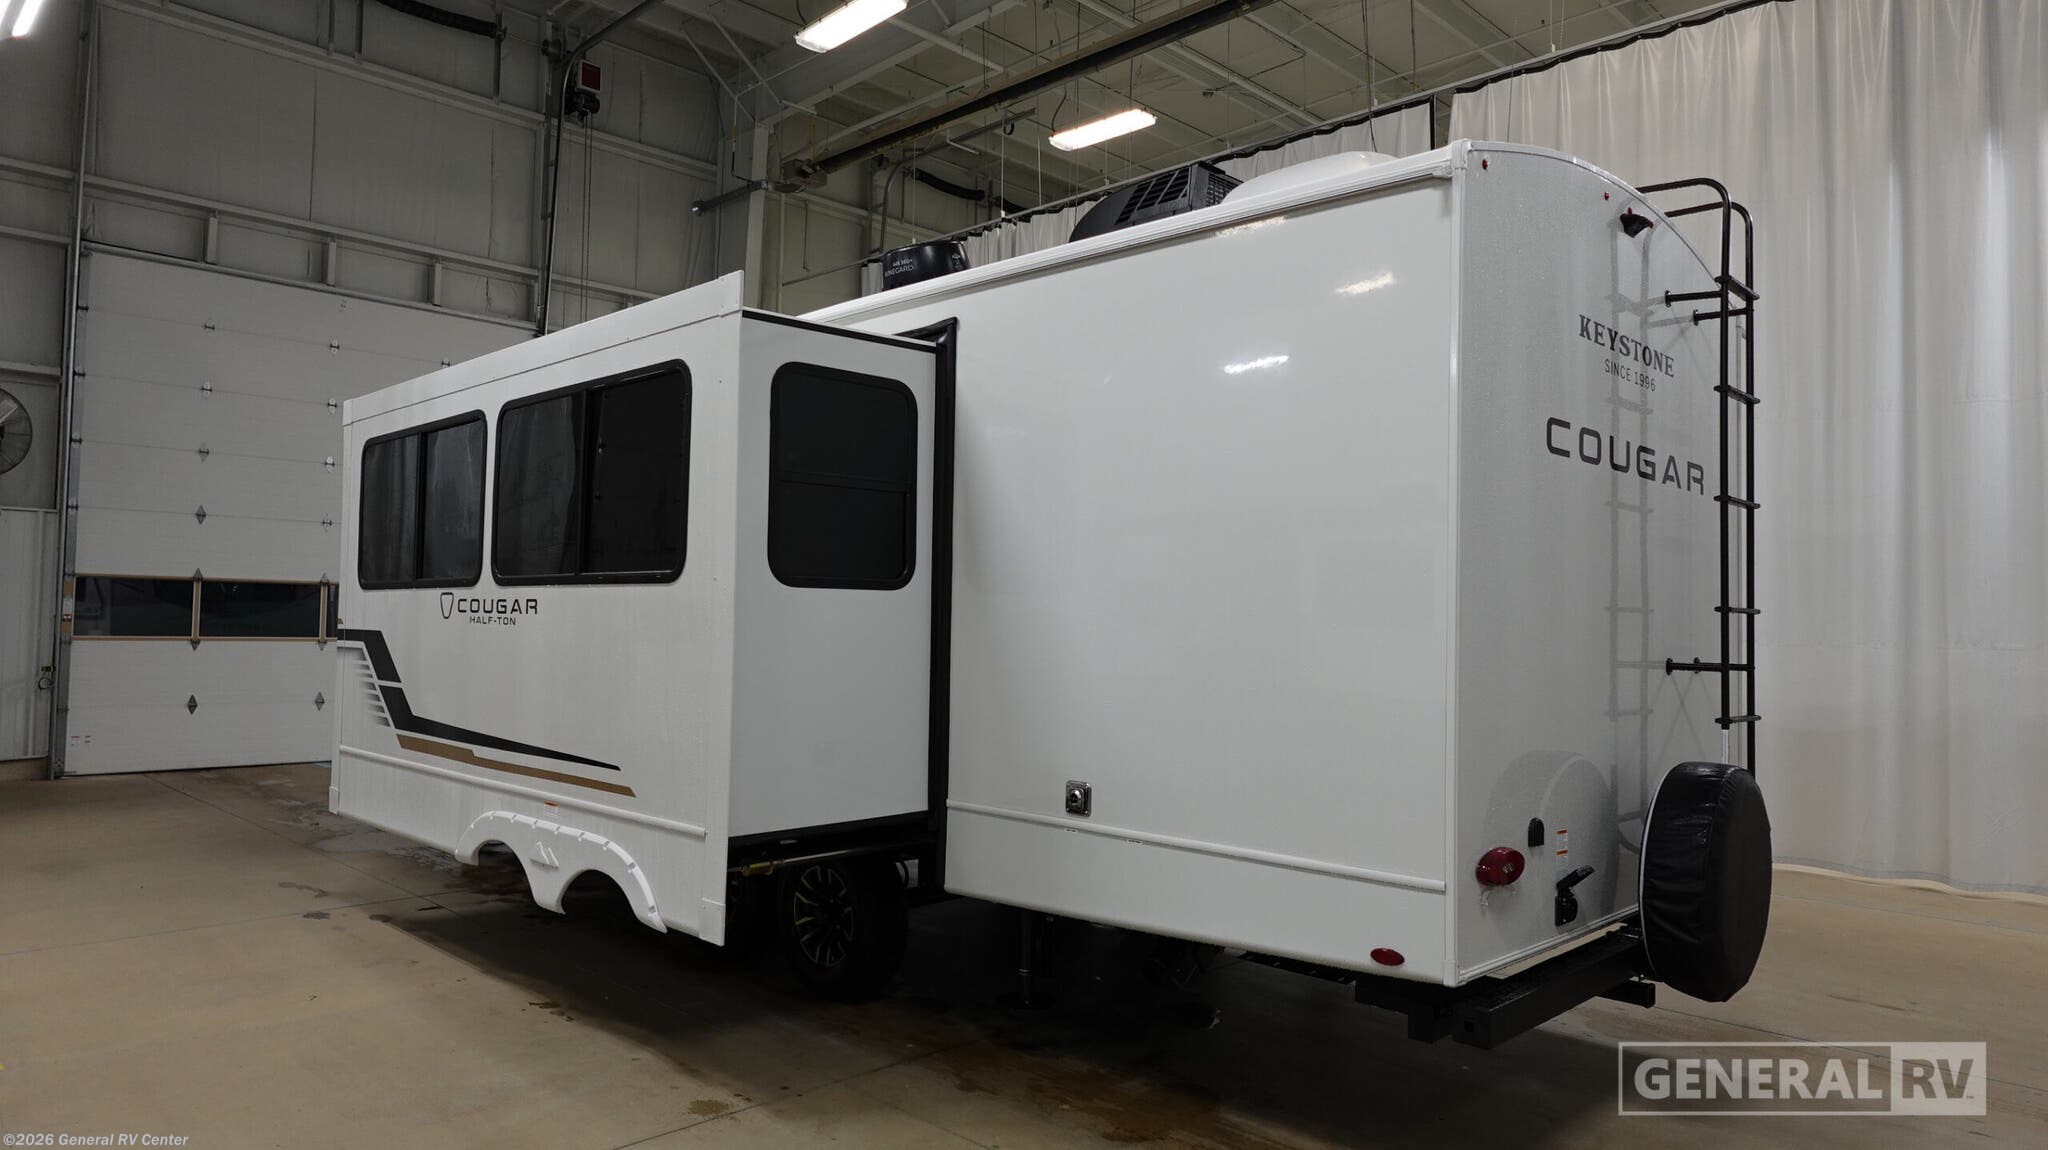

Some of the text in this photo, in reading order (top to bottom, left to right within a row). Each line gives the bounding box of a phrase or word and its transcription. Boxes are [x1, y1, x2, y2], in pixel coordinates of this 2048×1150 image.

[1579, 314, 1674, 378] KEYSTONE
[1604, 359, 1656, 392] SINCE 1996
[1546, 416, 1704, 496] COUGAR
[457, 598, 538, 614] COUGAR
[469, 616, 517, 626] HALF-TON
